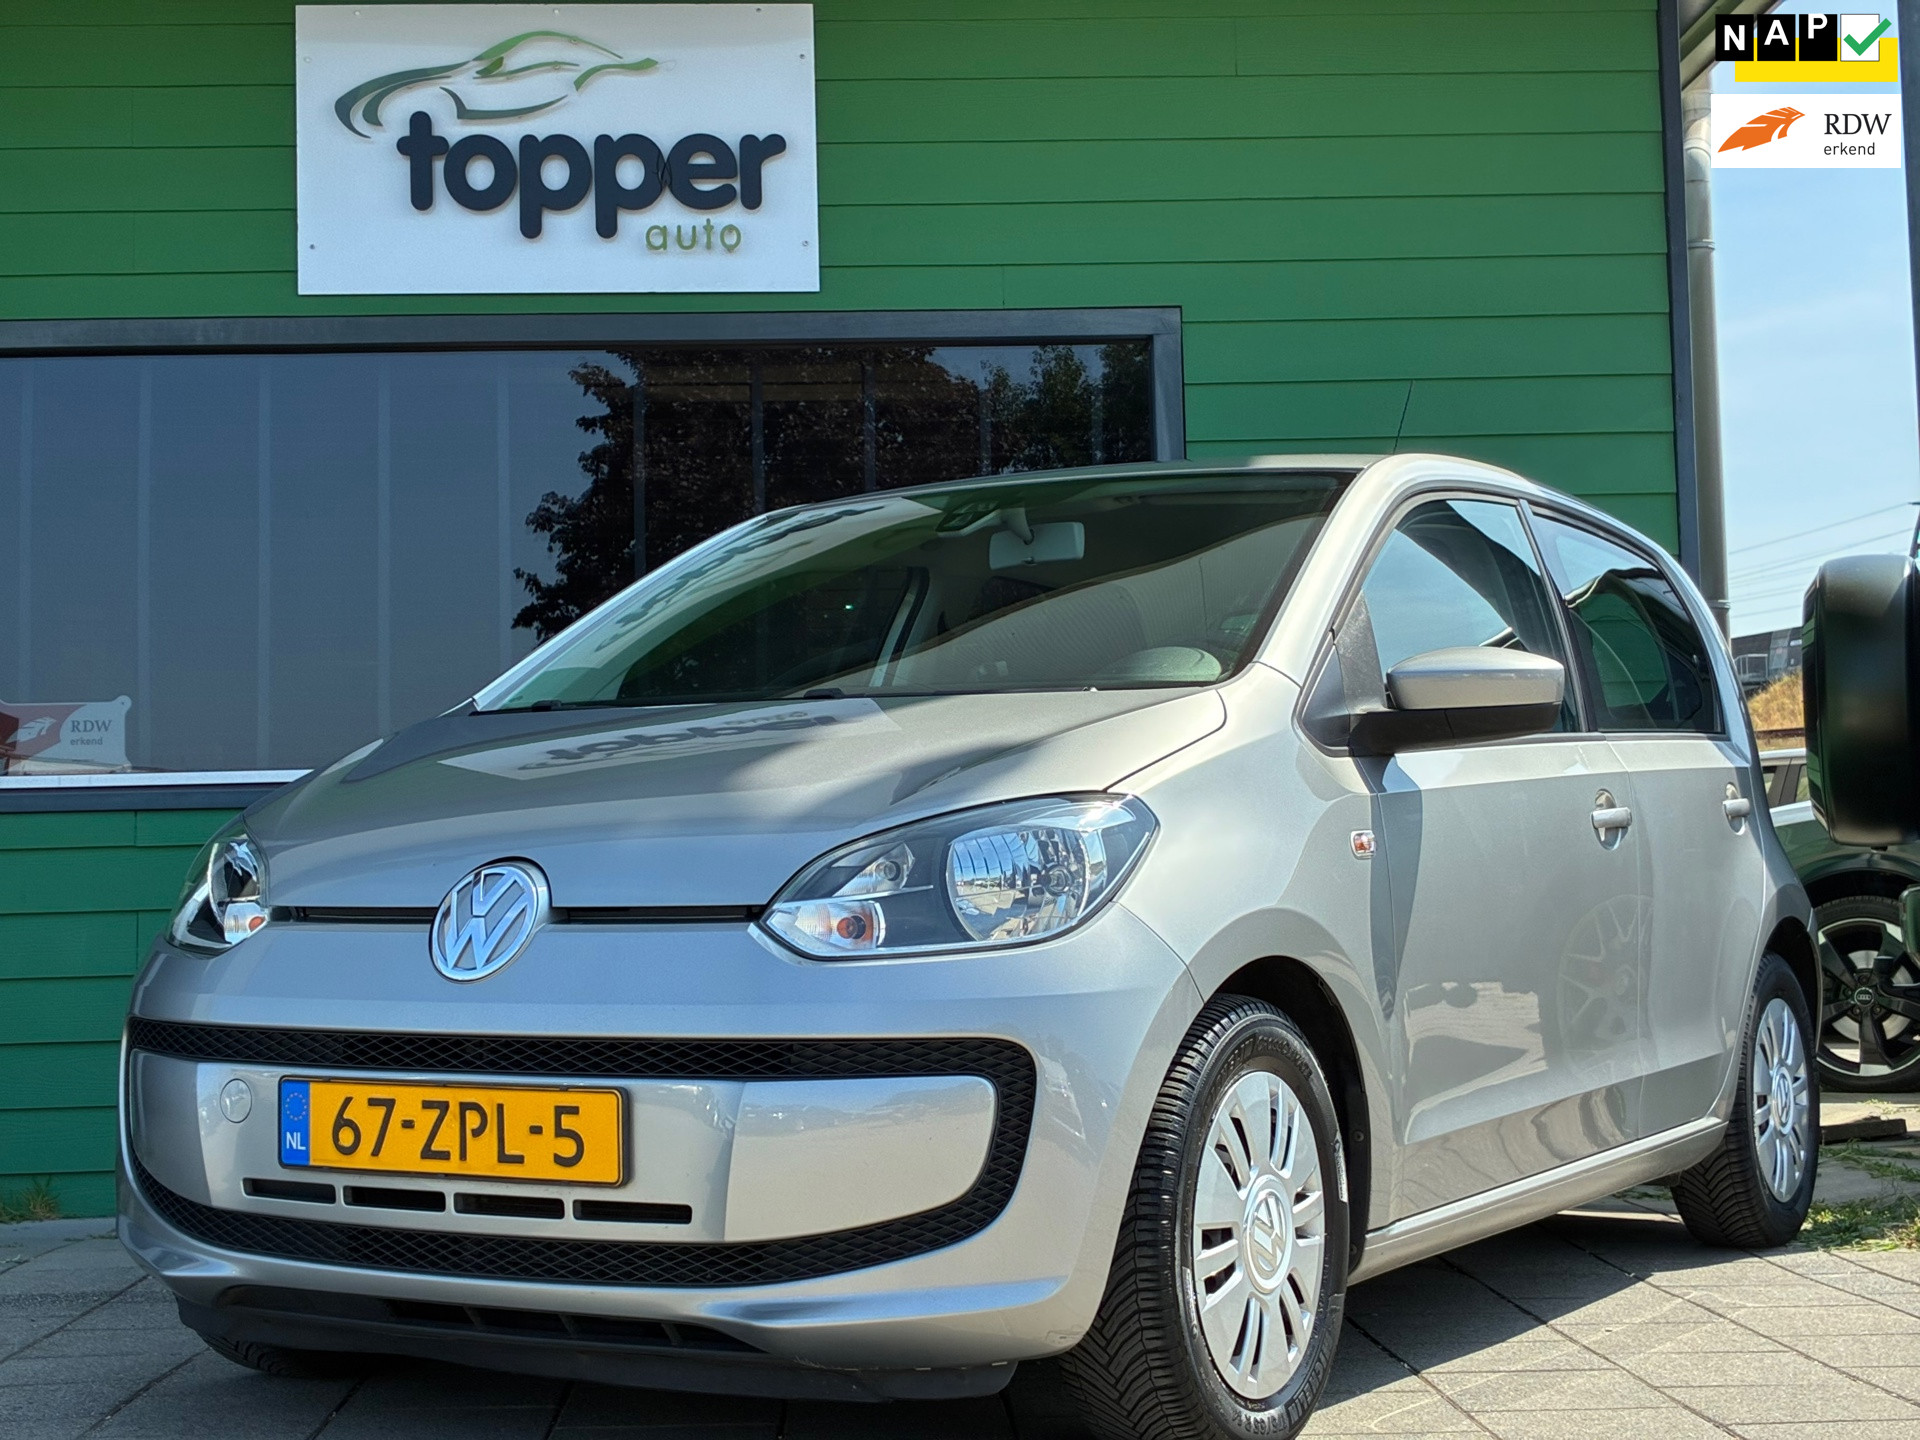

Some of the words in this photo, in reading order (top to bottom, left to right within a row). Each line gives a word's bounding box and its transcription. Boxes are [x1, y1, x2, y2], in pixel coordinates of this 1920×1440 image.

[396, 110, 788, 240] topper
[645, 218, 743, 253] auto
[71, 720, 112, 733] RDW
[70, 737, 104, 746] erkend
[285, 1131, 307, 1151] NL
[331, 1096, 585, 1168] 67-ZPL-5
